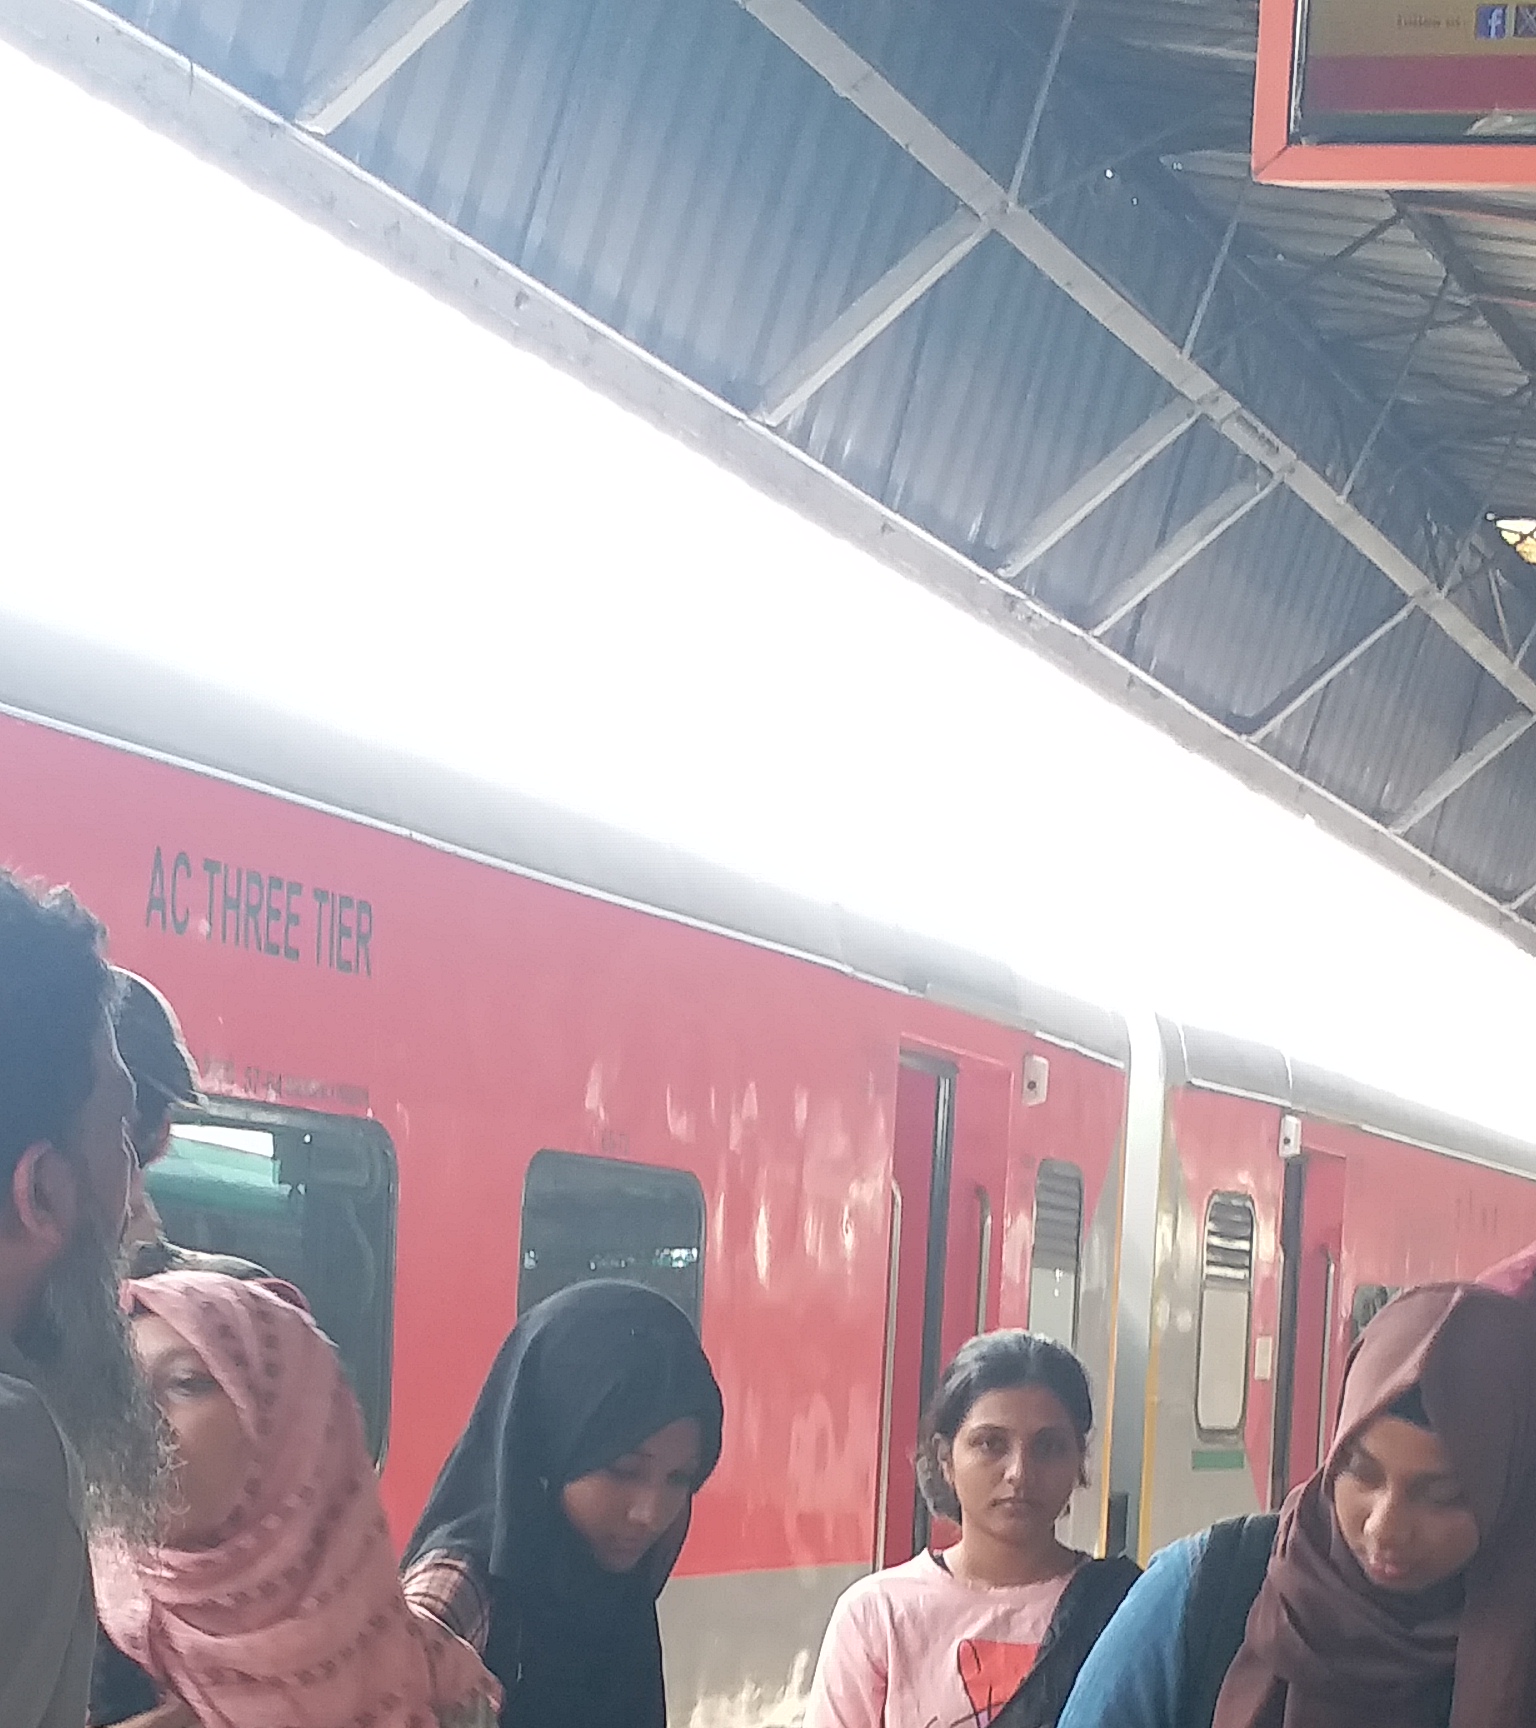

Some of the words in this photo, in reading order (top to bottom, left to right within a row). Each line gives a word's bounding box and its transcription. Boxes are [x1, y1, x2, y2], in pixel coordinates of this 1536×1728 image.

[146, 845, 191, 936] AC
[203, 857, 303, 962] THREE
[313, 886, 373, 978] TIER
